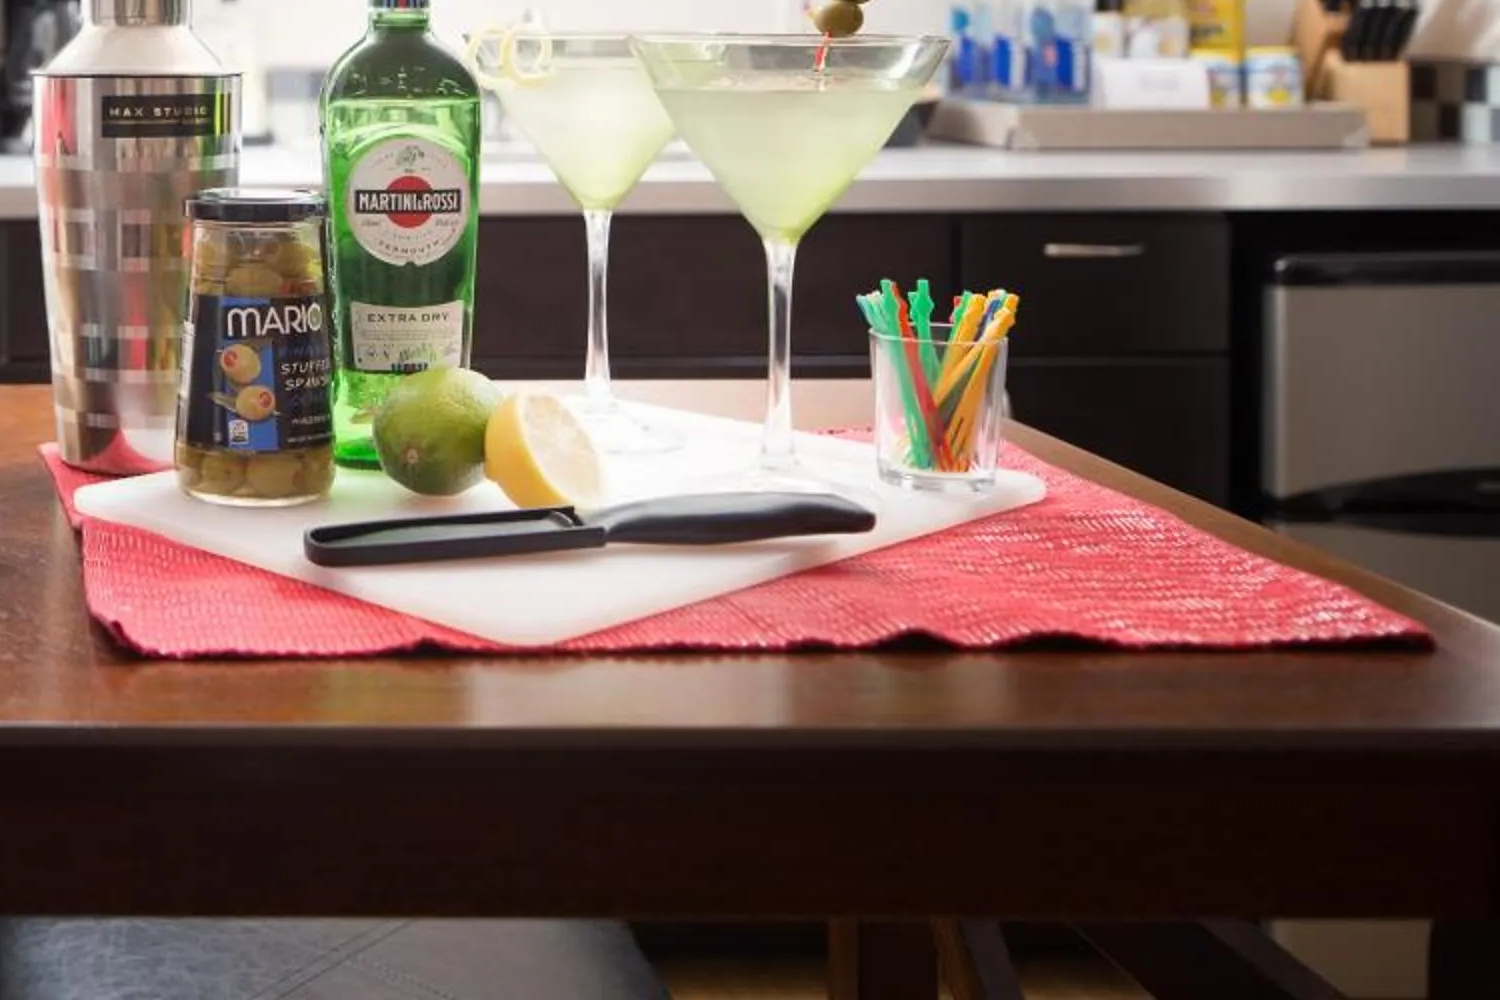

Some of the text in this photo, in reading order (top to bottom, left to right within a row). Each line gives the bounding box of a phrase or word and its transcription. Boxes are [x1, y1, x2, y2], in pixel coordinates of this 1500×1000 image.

[109, 107, 143, 117] MAX
[227, 302, 323, 338] MARIO
[367, 311, 451, 323] EXTRA DRY
